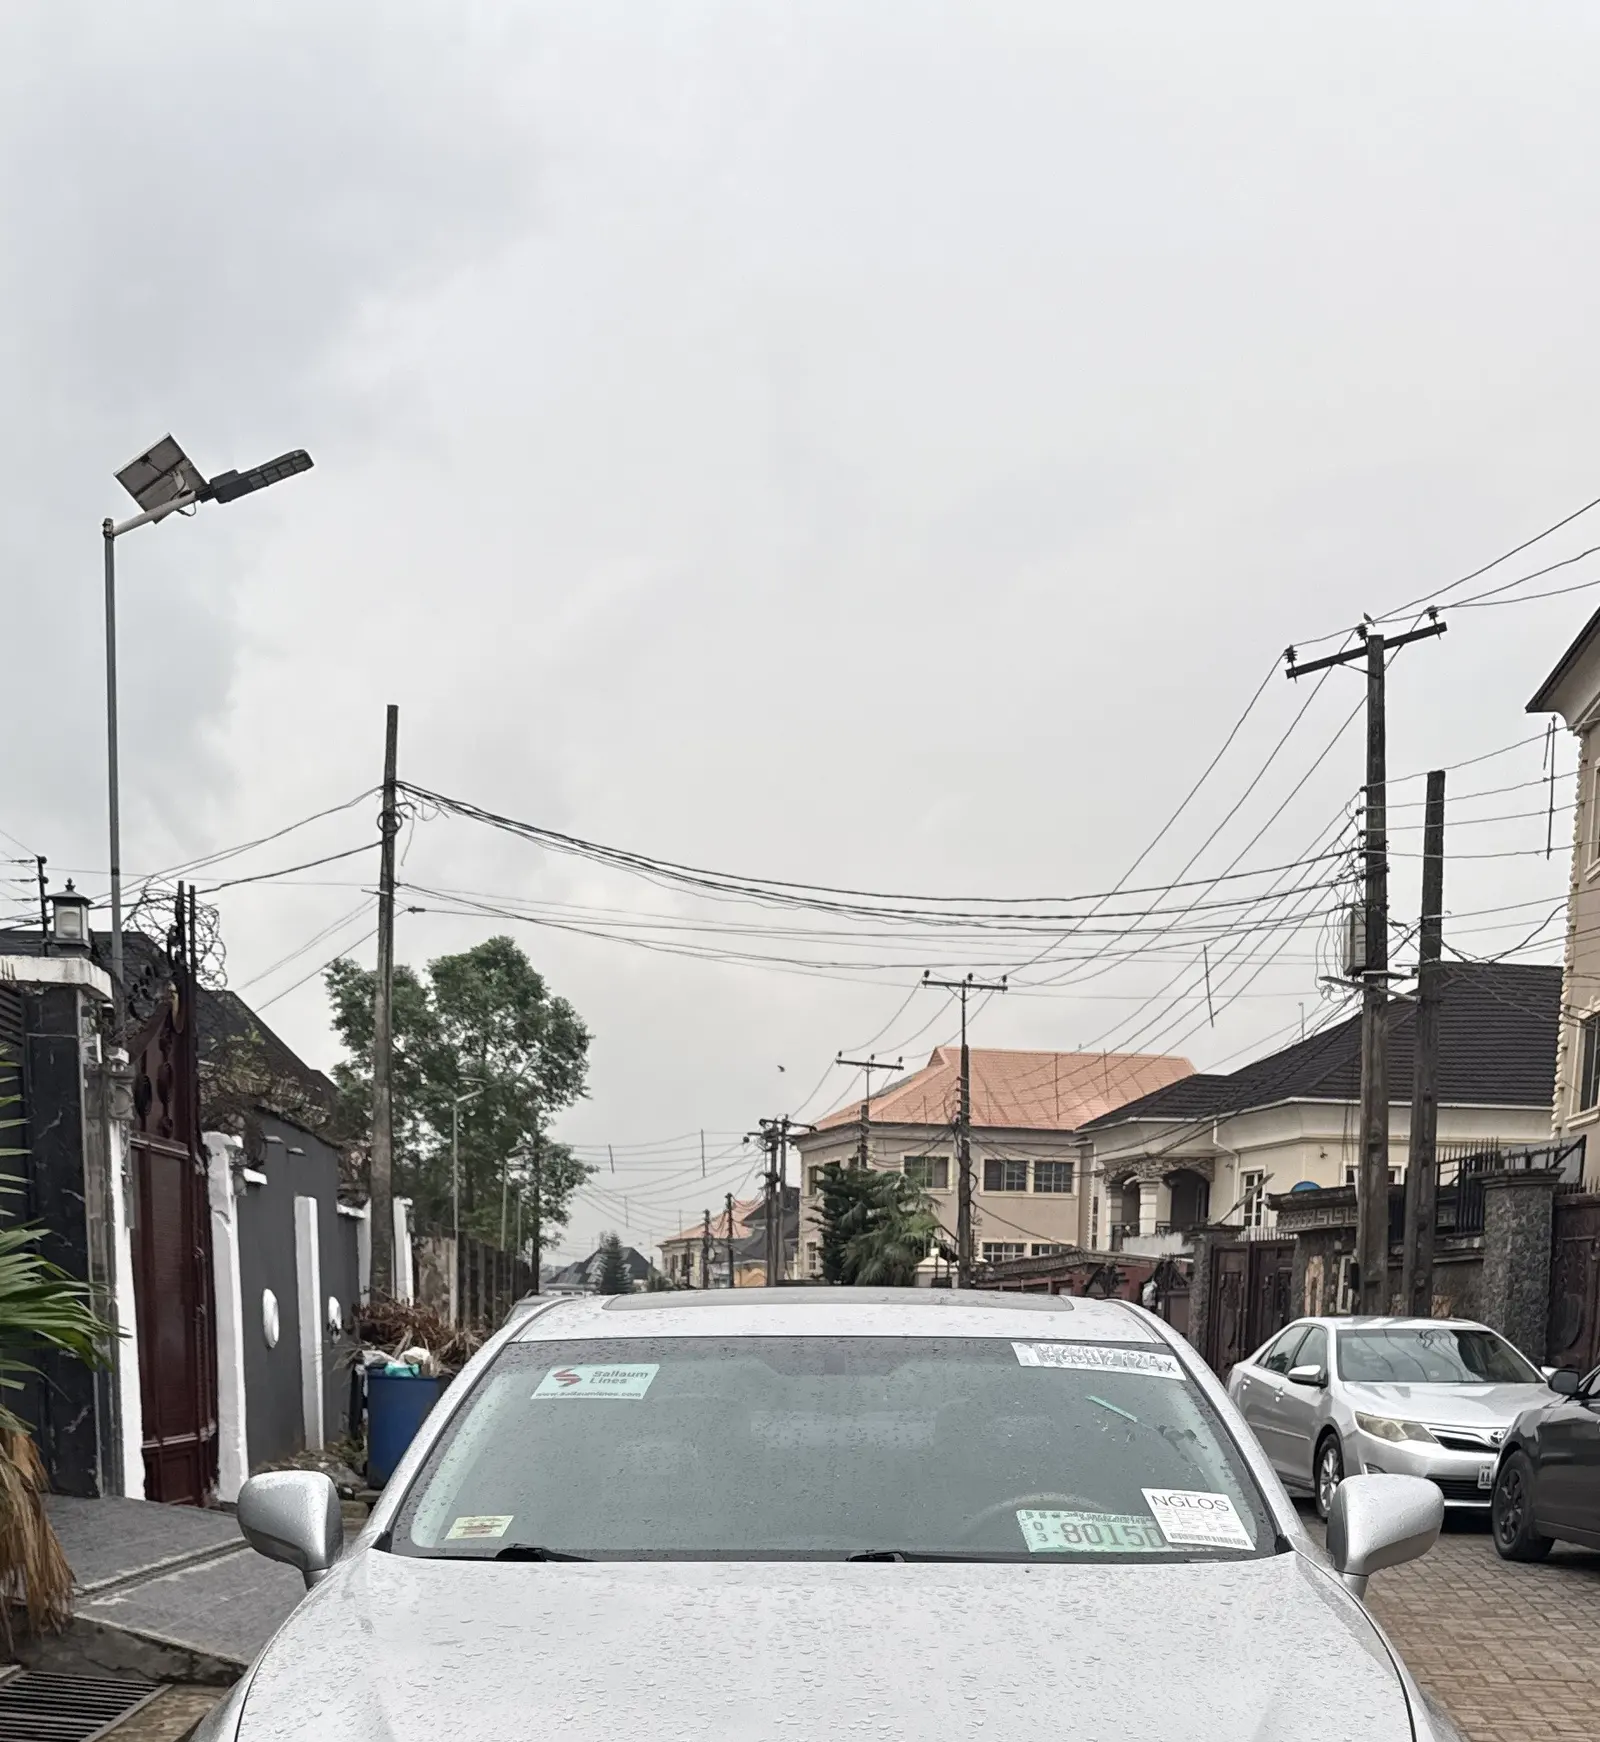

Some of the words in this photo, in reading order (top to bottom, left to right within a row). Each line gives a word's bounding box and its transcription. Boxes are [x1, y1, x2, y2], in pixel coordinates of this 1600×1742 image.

[592, 1370, 649, 1379] Sallaum
[589, 1377, 628, 1385] Lines
[1151, 1495, 1230, 1512] NGLOS
